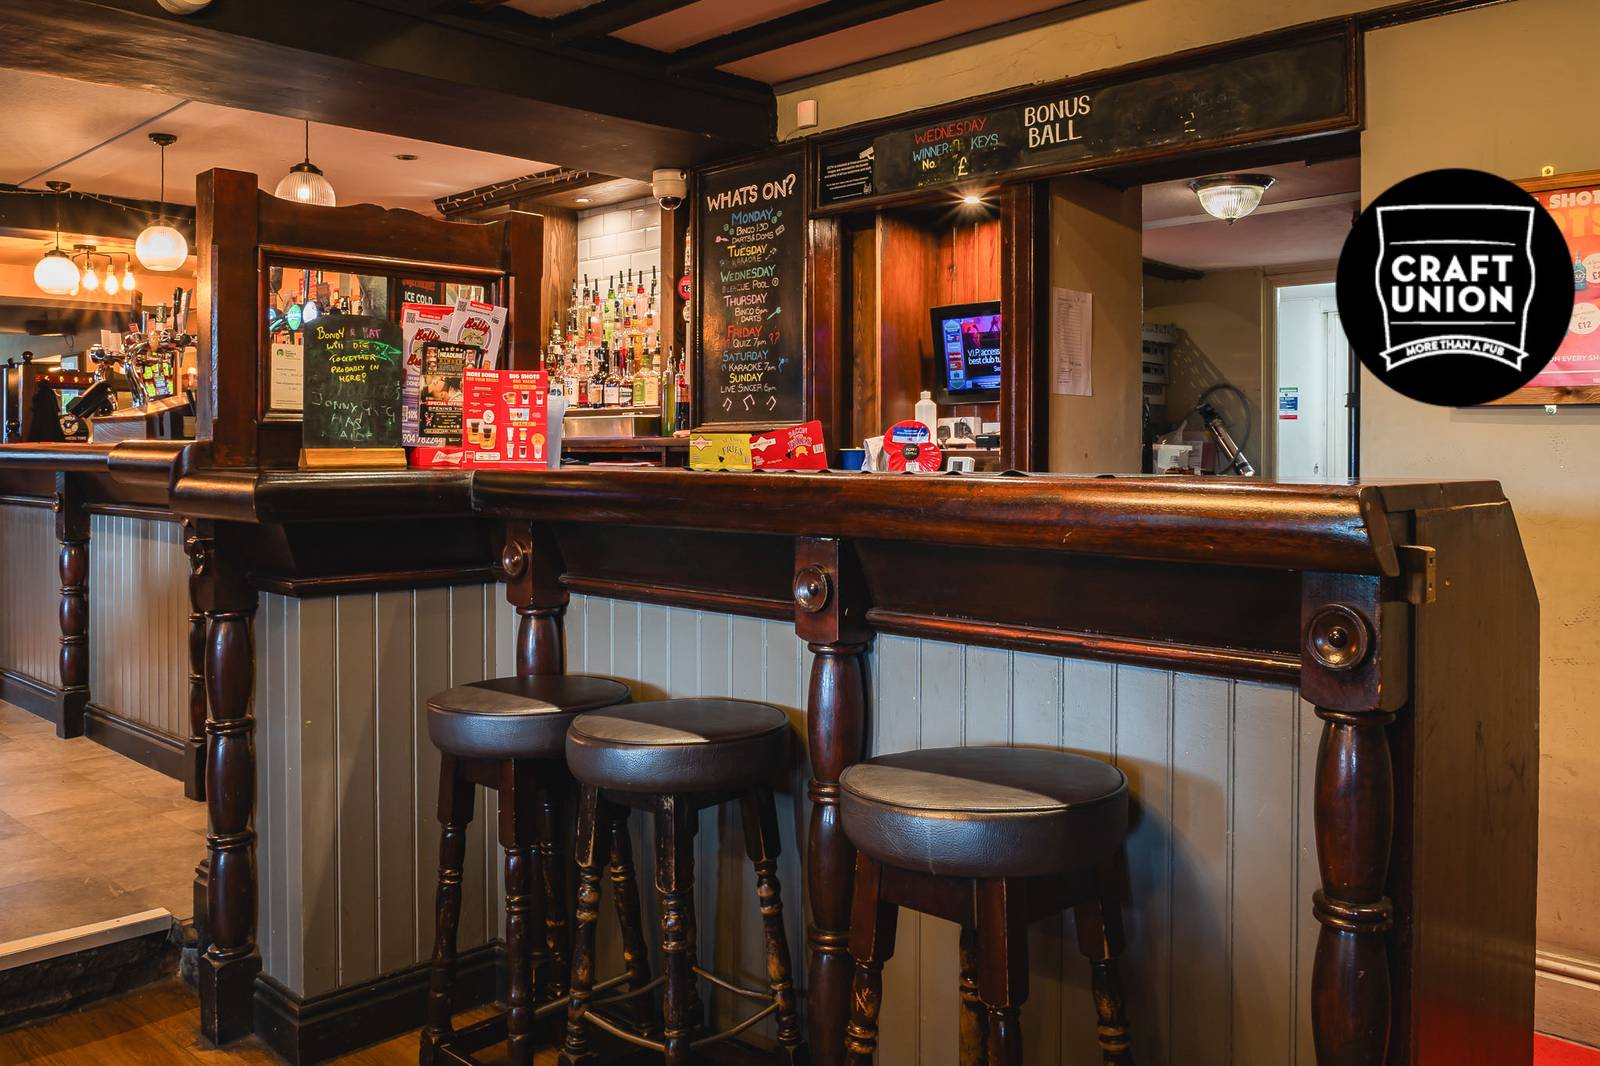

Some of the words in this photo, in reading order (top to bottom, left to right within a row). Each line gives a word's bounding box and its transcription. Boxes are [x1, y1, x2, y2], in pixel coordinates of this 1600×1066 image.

[1024, 95, 1090, 126] BONUS
[914, 117, 987, 145] WEDNESDAY
[1029, 120, 1082, 148] BALL
[971, 134, 998, 150] KEYS
[958, 156, 968, 176] £
[707, 184, 758, 212] WHATS
[762, 173, 796, 200] ON?
[731, 207, 774, 225] MONDAY
[736, 225, 755, 236] BINGO
[727, 244, 768, 257] TUESDAY
[720, 265, 776, 282] WEDNESDAY
[752, 280, 770, 290] POOL
[404, 291, 415, 302] ICE
[416, 292, 433, 304] COLD
[724, 293, 768, 307] THURSDAY
[735, 307, 754, 317] BINGO
[741, 315, 761, 323] DARTS
[464, 316, 490, 336] Belly
[727, 325, 763, 338] FRIDAY
[732, 339, 751, 348] QUIZ
[754, 337, 767, 346] 7pm
[723, 350, 768, 362] SATURDAY
[981, 348, 1000, 356] access
[982, 356, 995, 364] club
[729, 363, 763, 372] KARAOKE
[729, 372, 764, 384] SUNDAY
[720, 385, 735, 393] LIVE
[738, 384, 761, 392] SINGER
[722, 446, 743, 455] FRIES
